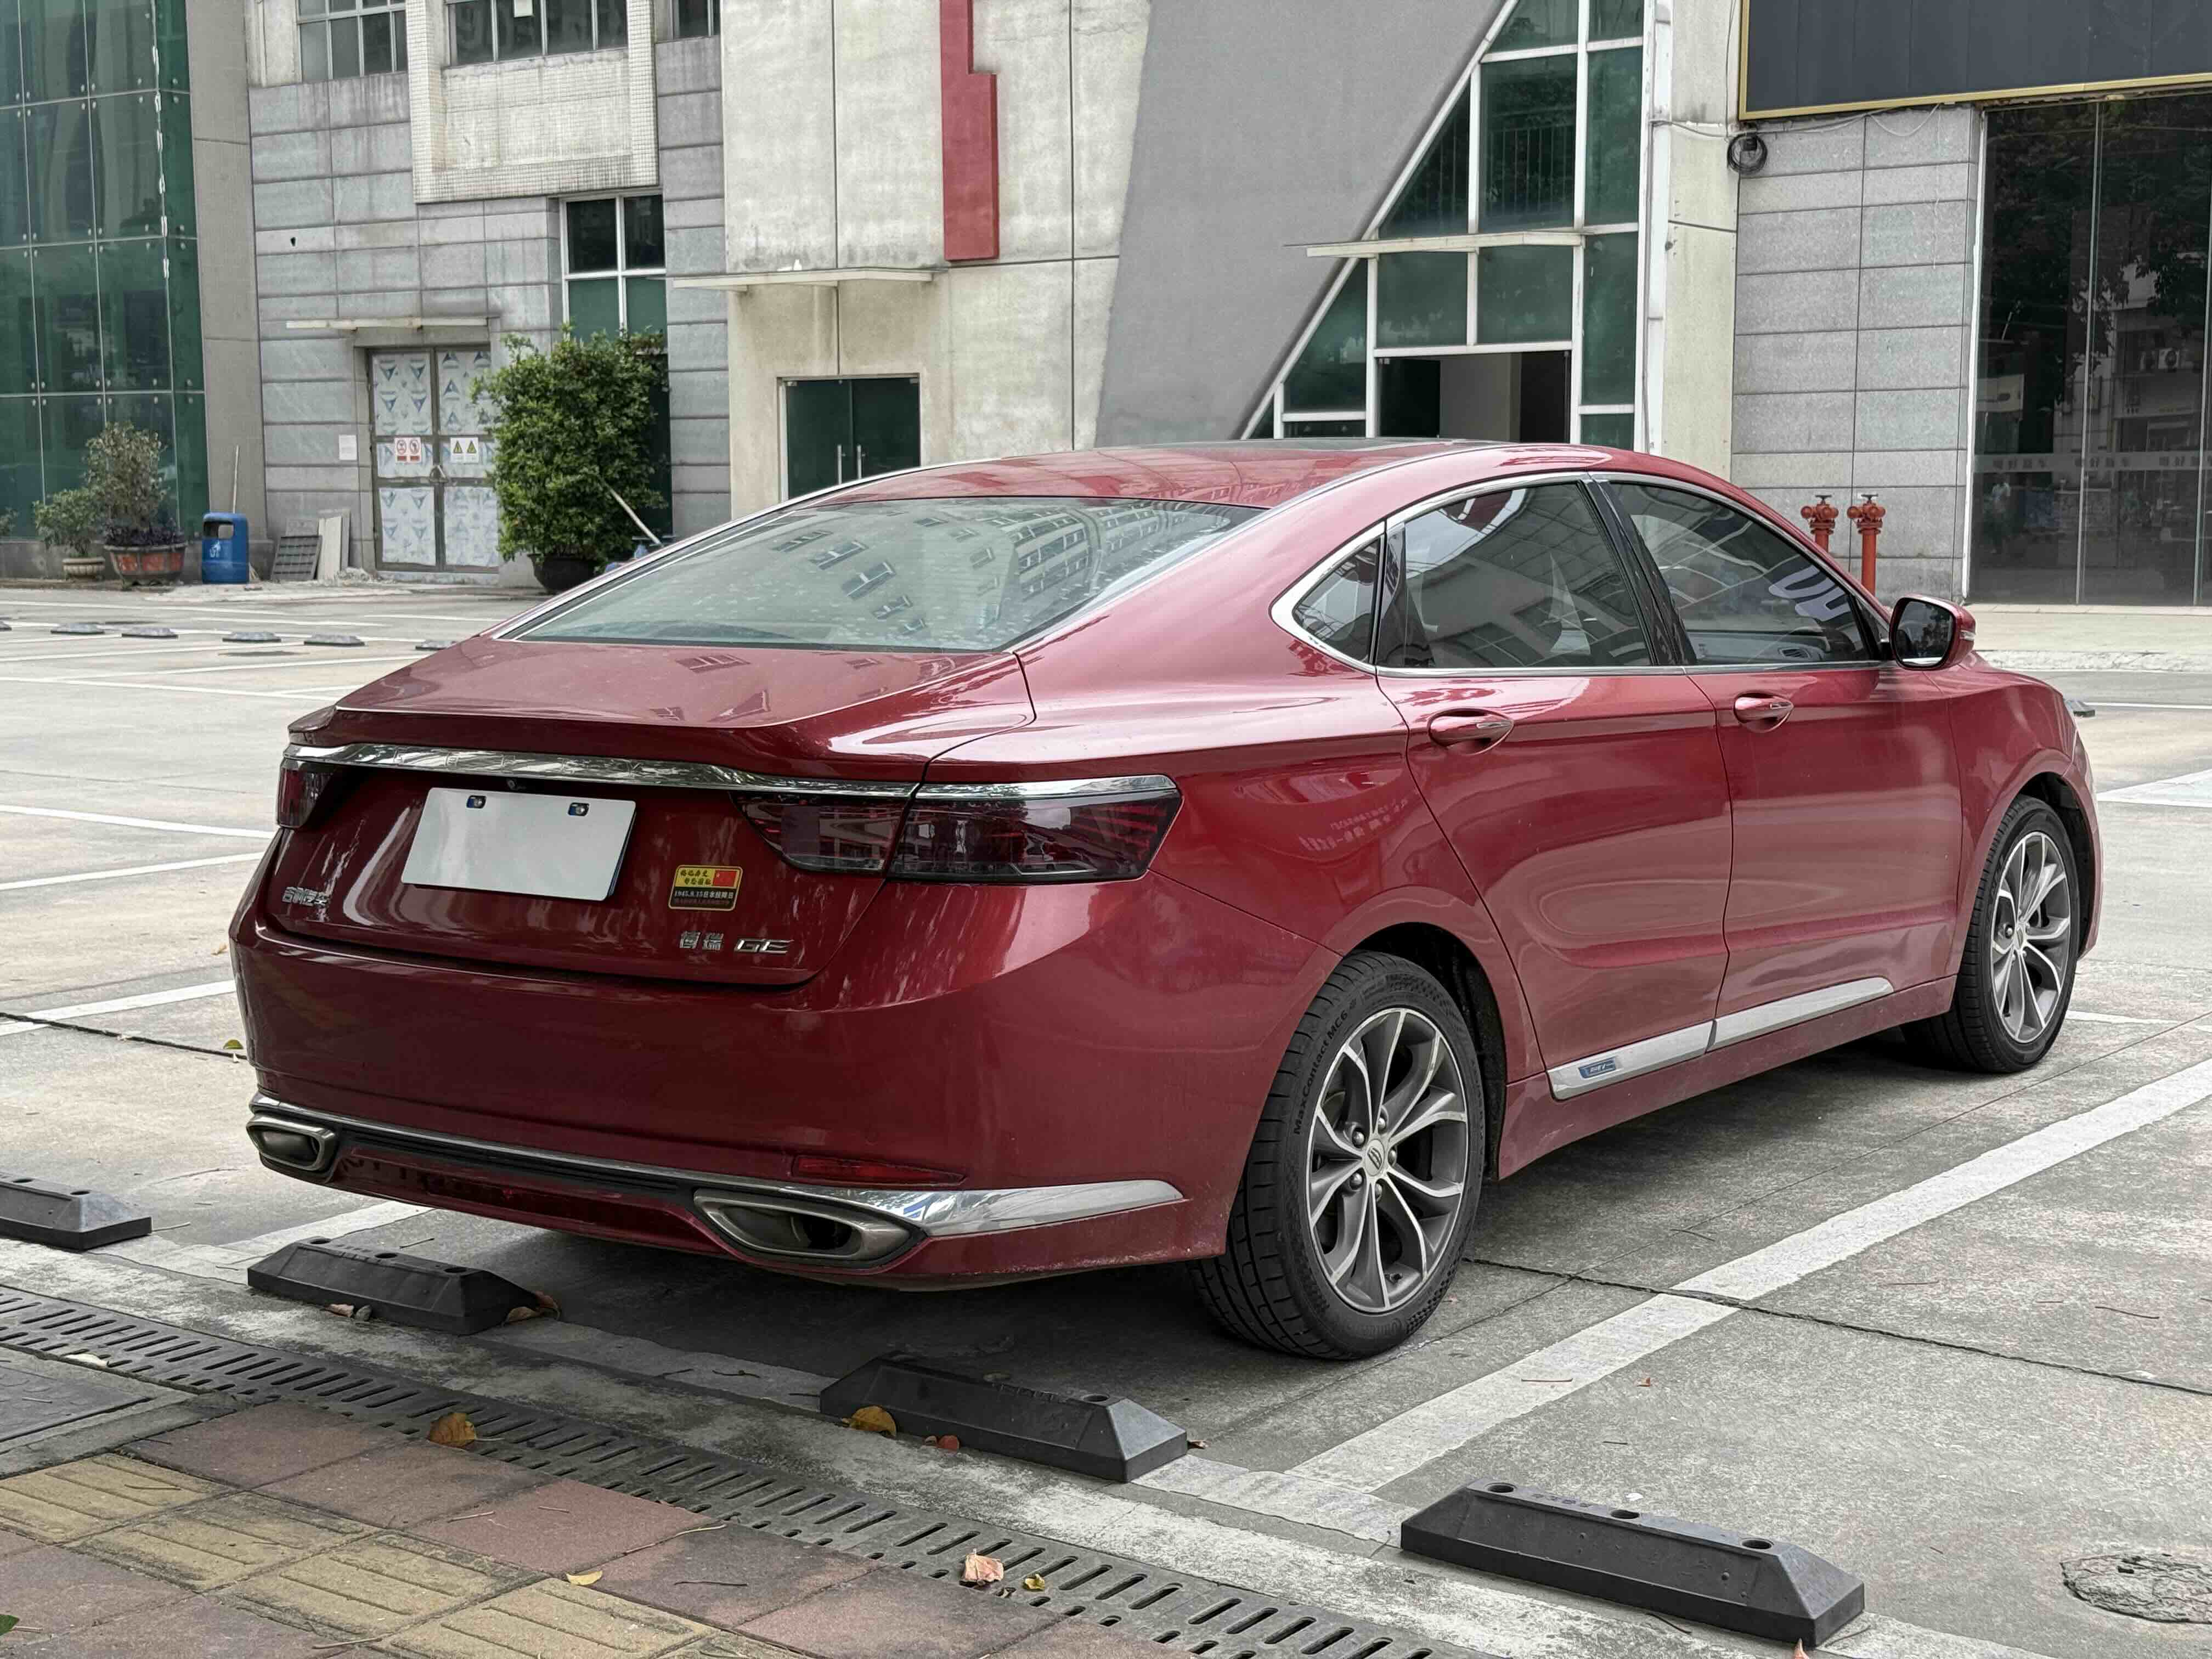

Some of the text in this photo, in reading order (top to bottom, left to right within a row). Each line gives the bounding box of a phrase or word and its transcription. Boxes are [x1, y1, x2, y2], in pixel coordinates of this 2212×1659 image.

[733, 938, 795, 954] GE
[1294, 1010, 1348, 1135] MaxContact MC6
